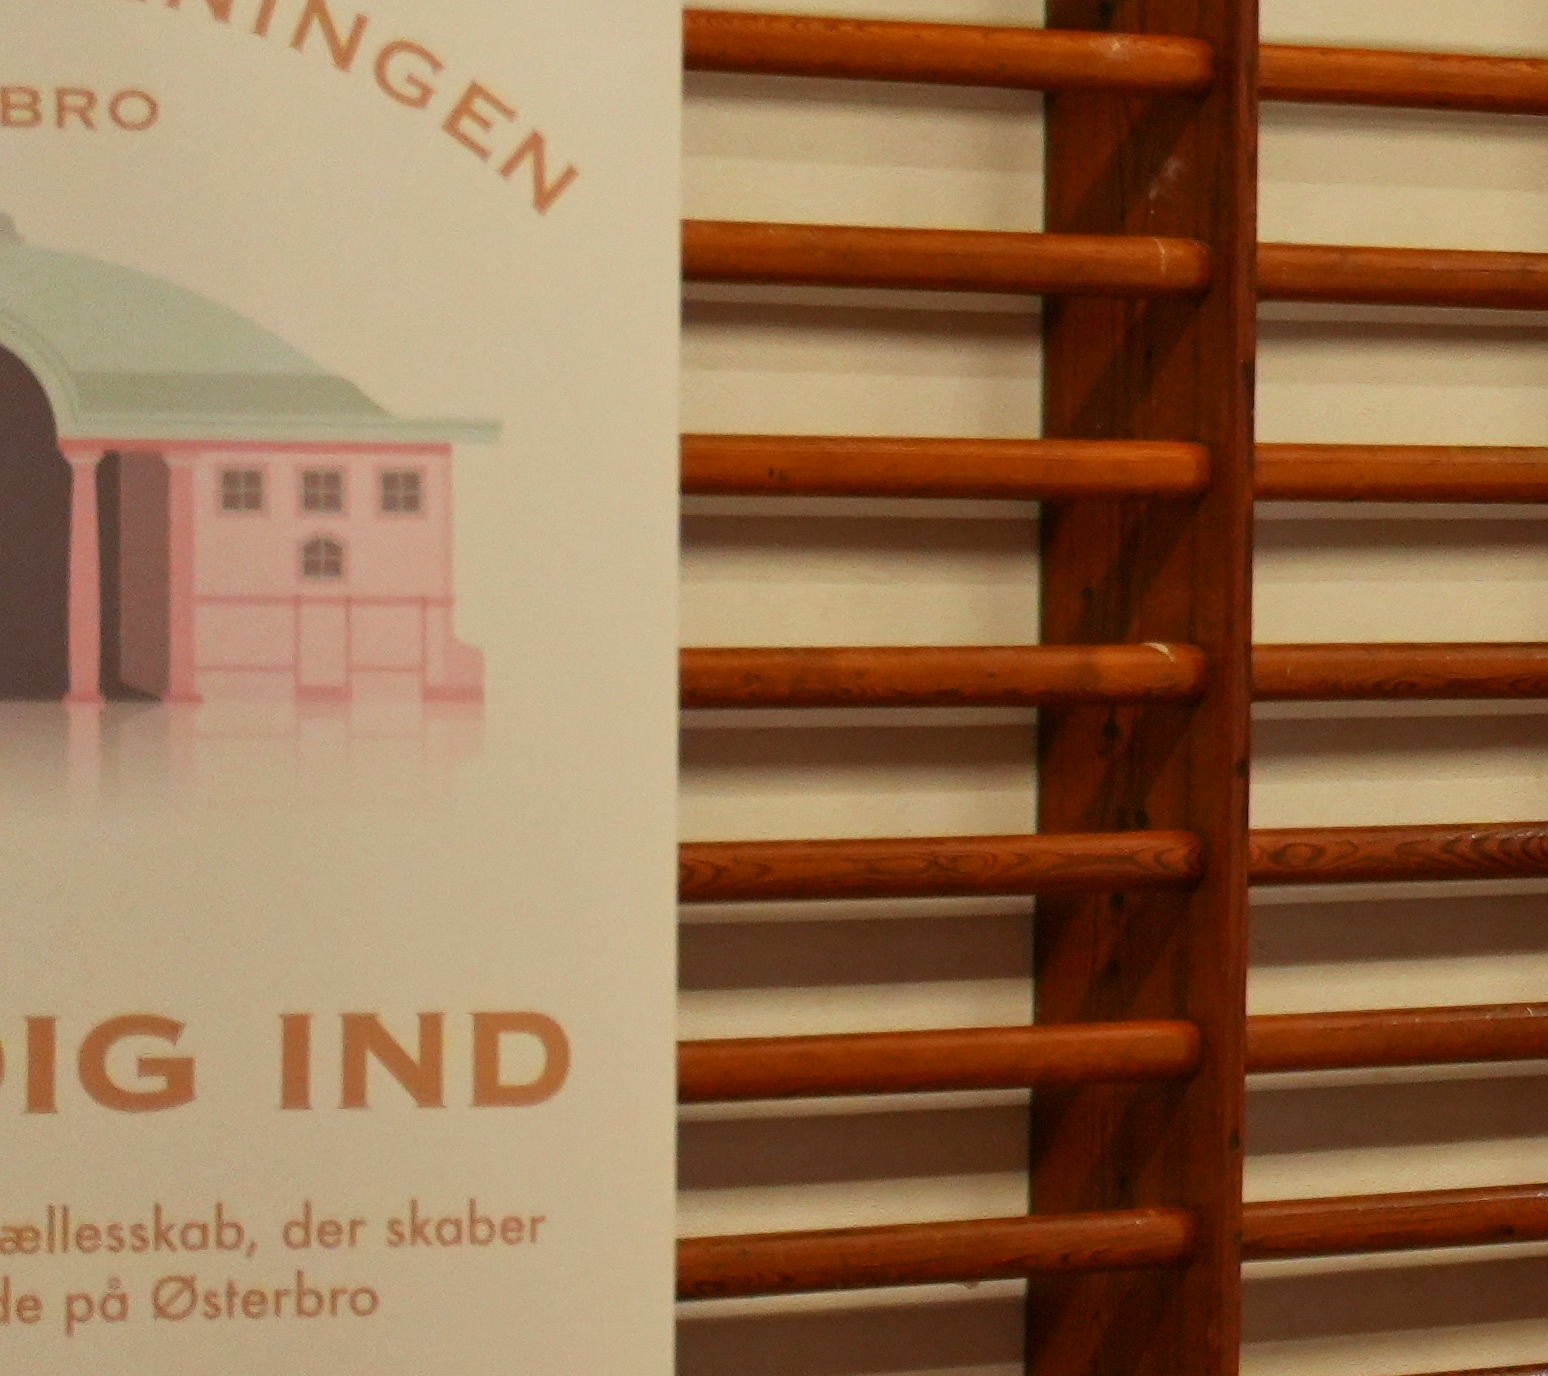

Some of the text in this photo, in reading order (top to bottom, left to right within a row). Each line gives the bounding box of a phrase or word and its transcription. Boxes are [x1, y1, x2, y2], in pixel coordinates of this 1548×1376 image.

[1, 86, 160, 131] BRO
[0, 1010, 572, 1114] IG IND
[282, 1200, 366, 1251] der
[386, 1198, 547, 1248] skaber
[66, 1276, 130, 1338] på
[152, 1269, 380, 1322] Østerbro
